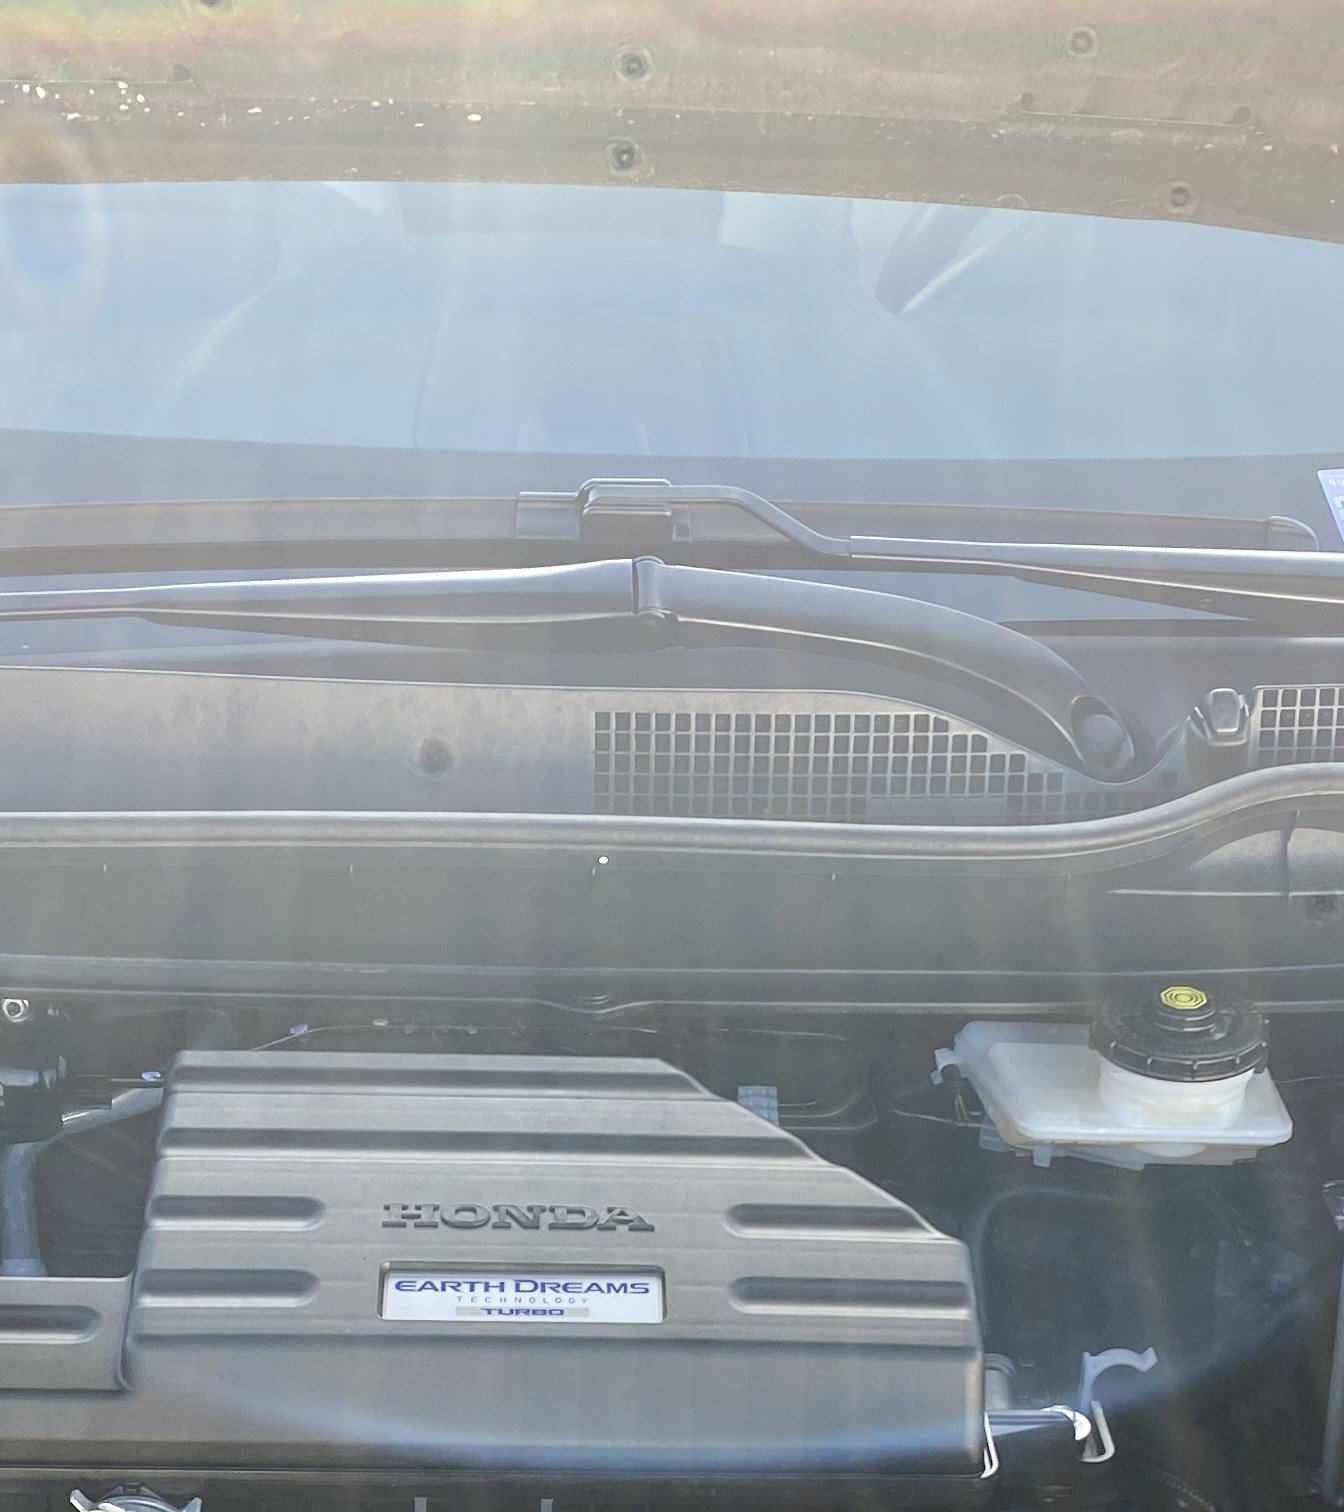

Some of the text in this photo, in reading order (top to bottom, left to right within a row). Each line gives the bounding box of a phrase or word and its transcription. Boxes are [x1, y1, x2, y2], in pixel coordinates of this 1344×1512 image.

[382, 1203, 655, 1232] HONDA
[394, 1278, 650, 1295] EARTH DREAMS
[456, 1296, 589, 1305] TECHNOLOGY
[481, 1307, 565, 1317] TURBO
